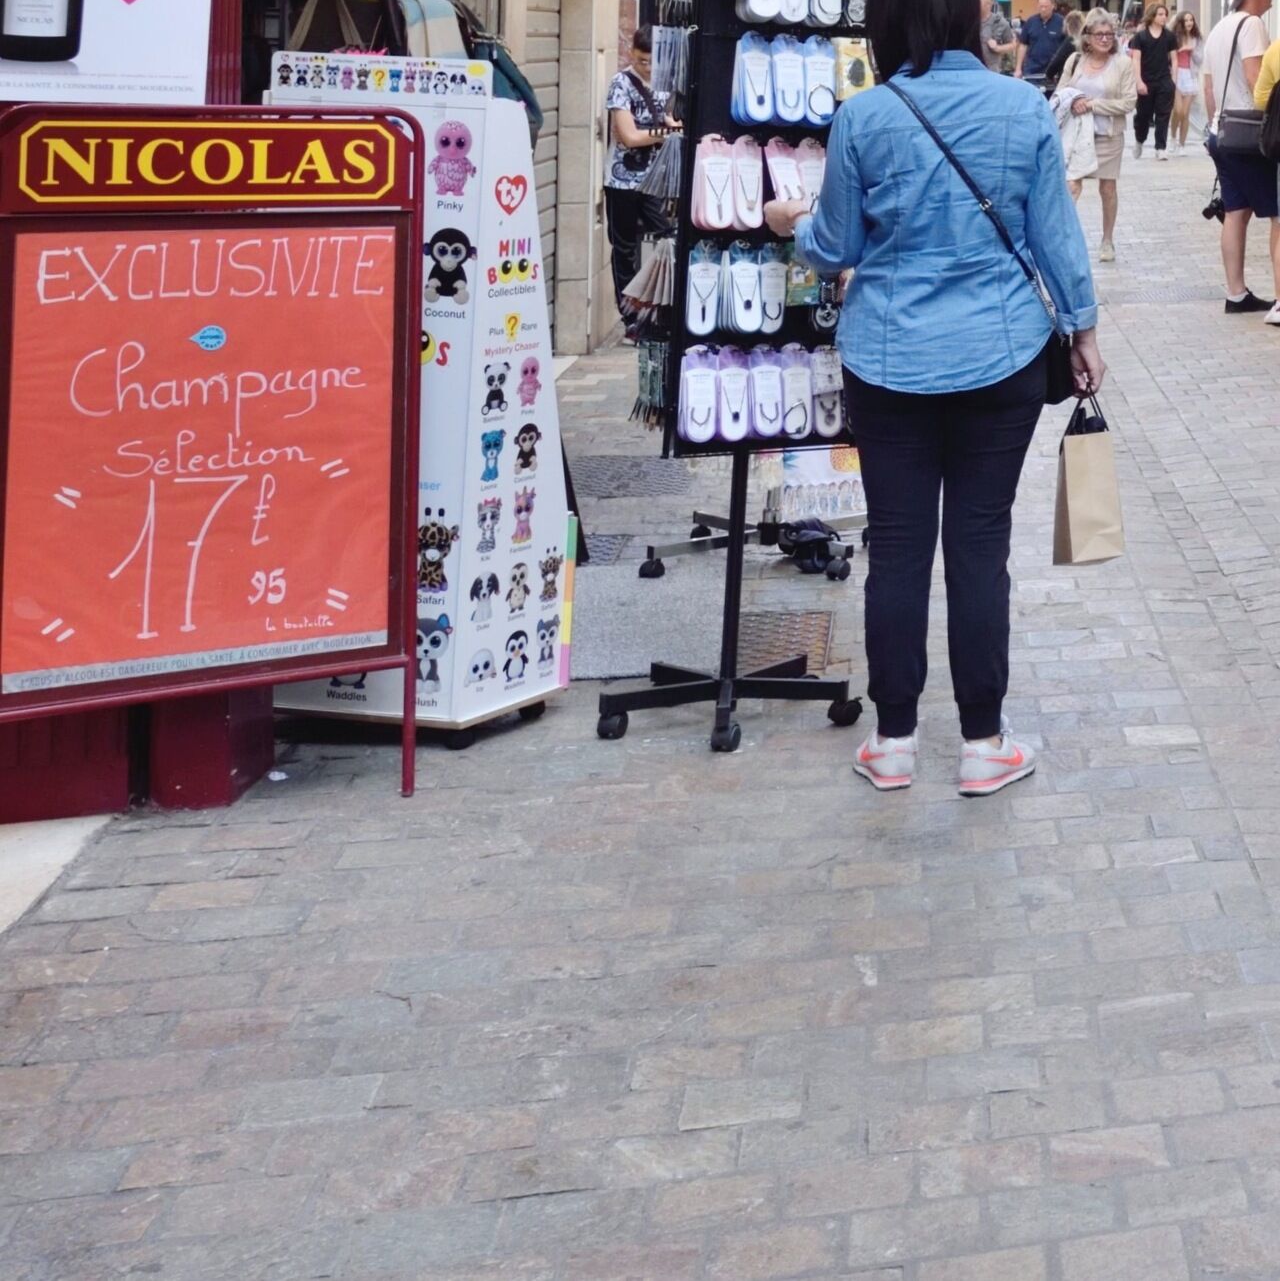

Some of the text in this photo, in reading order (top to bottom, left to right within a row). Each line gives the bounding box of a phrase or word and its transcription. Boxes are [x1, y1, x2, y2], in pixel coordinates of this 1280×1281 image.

[41, 138, 376, 185] NICOLAS
[498, 179, 524, 206] ty
[437, 200, 464, 212] Pinky
[499, 237, 531, 257] MINI
[488, 285, 537, 298] Collectibles
[424, 307, 466, 319] Coconut
[489, 327, 504, 336] Plus
[520, 322, 537, 332] Rare
[484, 340, 540, 358] Mystery Chaser
[70, 341, 367, 438] Champagne
[102, 430, 316, 478] Sélection
[109, 475, 249, 640] 17
[248, 568, 287, 606] 95
[416, 593, 446, 606] Safari
[247, 644, 298, 659] CONSOMMER
[301, 640, 320, 653] AVEC
[326, 689, 367, 701] Waddles
[416, 697, 438, 707] lush
